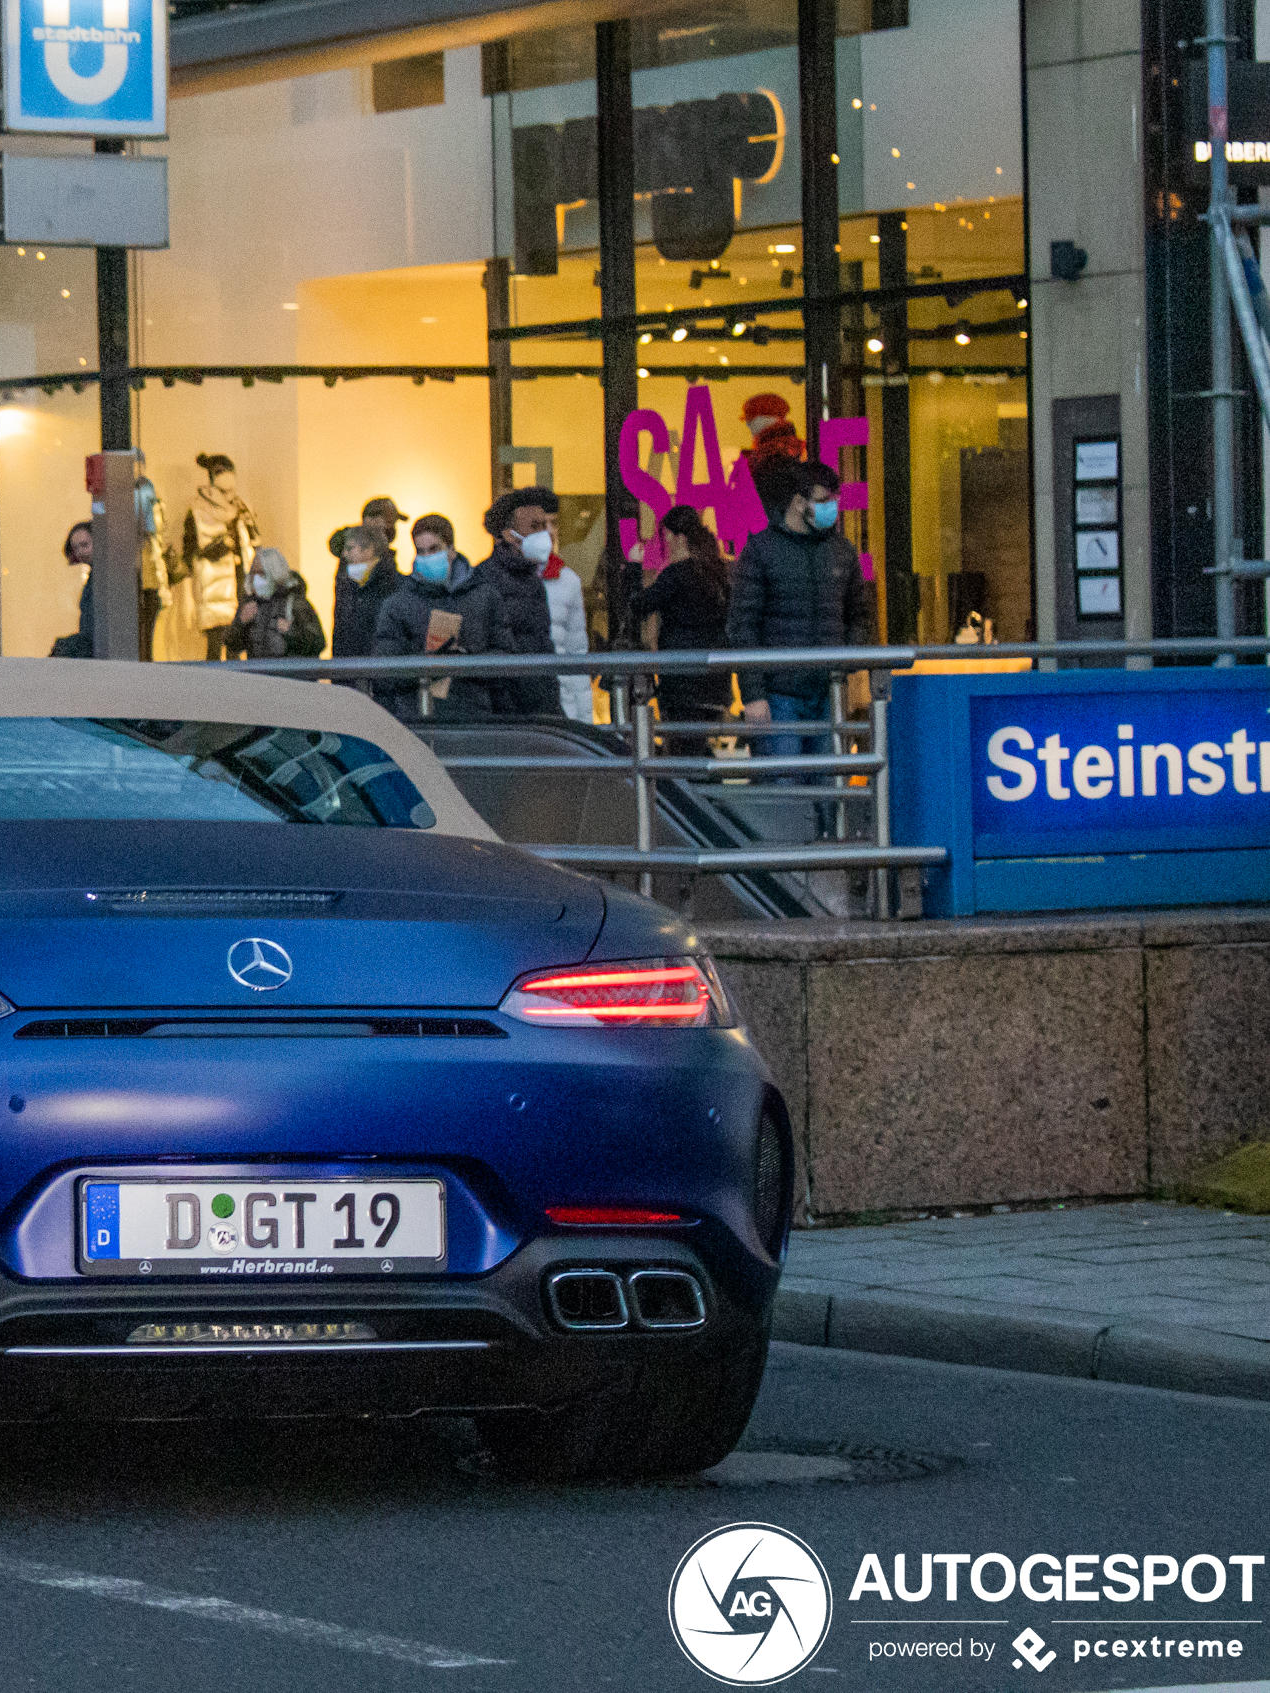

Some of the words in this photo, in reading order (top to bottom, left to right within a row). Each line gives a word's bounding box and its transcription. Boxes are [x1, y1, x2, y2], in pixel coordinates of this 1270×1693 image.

[32, 25, 141, 43] stadtbahn
[164, 1192, 201, 1250] D
[242, 1192, 318, 1249] GT
[331, 1192, 401, 1249] 19
[96, 1228, 111, 1247] D
[200, 1259, 335, 1275] www.Herbrand.de
